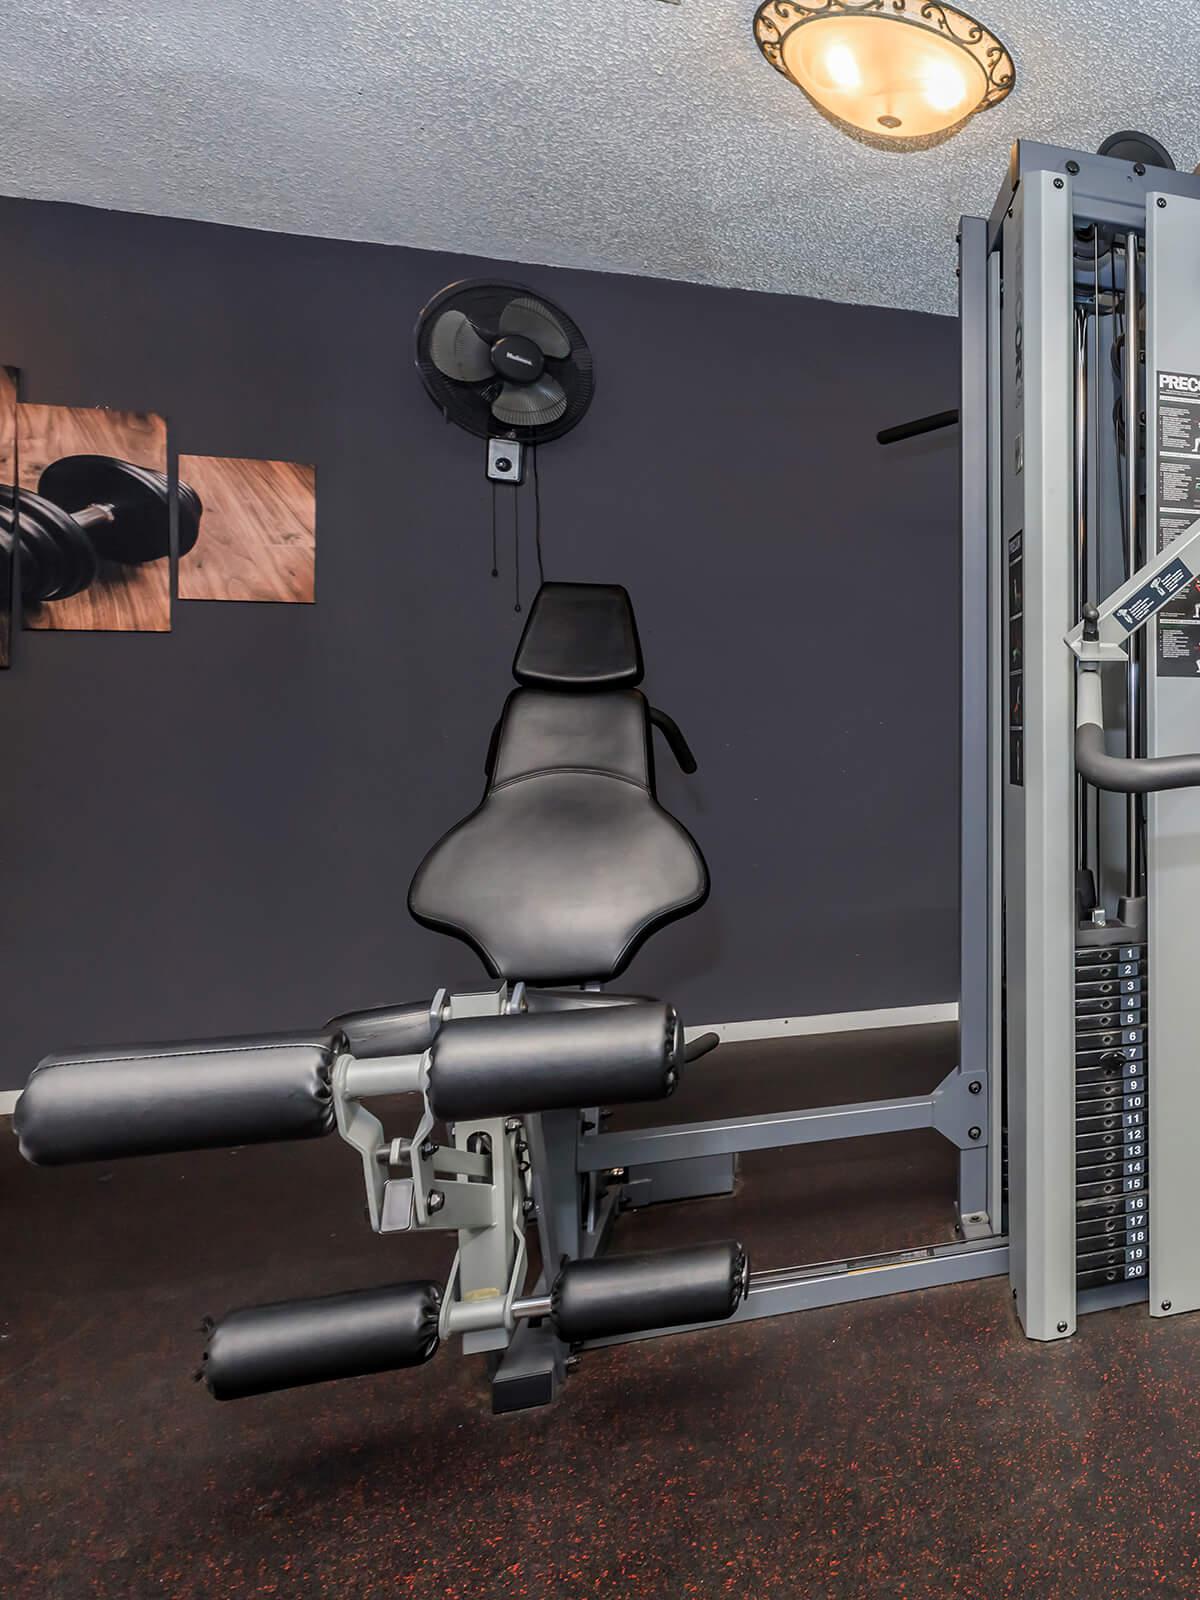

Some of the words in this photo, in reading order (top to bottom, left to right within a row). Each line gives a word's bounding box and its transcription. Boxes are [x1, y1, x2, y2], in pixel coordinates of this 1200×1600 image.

[1127, 949, 1133, 959] 1
[1124, 964, 1132, 975] 2
[1127, 981, 1135, 991] 3
[1127, 997, 1135, 1007] 4
[1127, 1013, 1134, 1024] 5
[1129, 1031, 1137, 1041] 6
[1129, 1048, 1137, 1058] 7
[1129, 1064, 1137, 1074] 8
[1130, 1080, 1138, 1090] 9
[1127, 1096, 1142, 1107] 10
[1127, 1113, 1139, 1124] 11
[1127, 1129, 1142, 1140] 12
[1128, 1145, 1142, 1156] 13
[1127, 1162, 1141, 1173] 14
[1127, 1178, 1141, 1189] 15
[1130, 1198, 1144, 1209] 16
[1130, 1215, 1144, 1226] 17
[1130, 1231, 1144, 1242] 18
[1129, 1248, 1143, 1260] 19
[1128, 1265, 1143, 1277] 20
